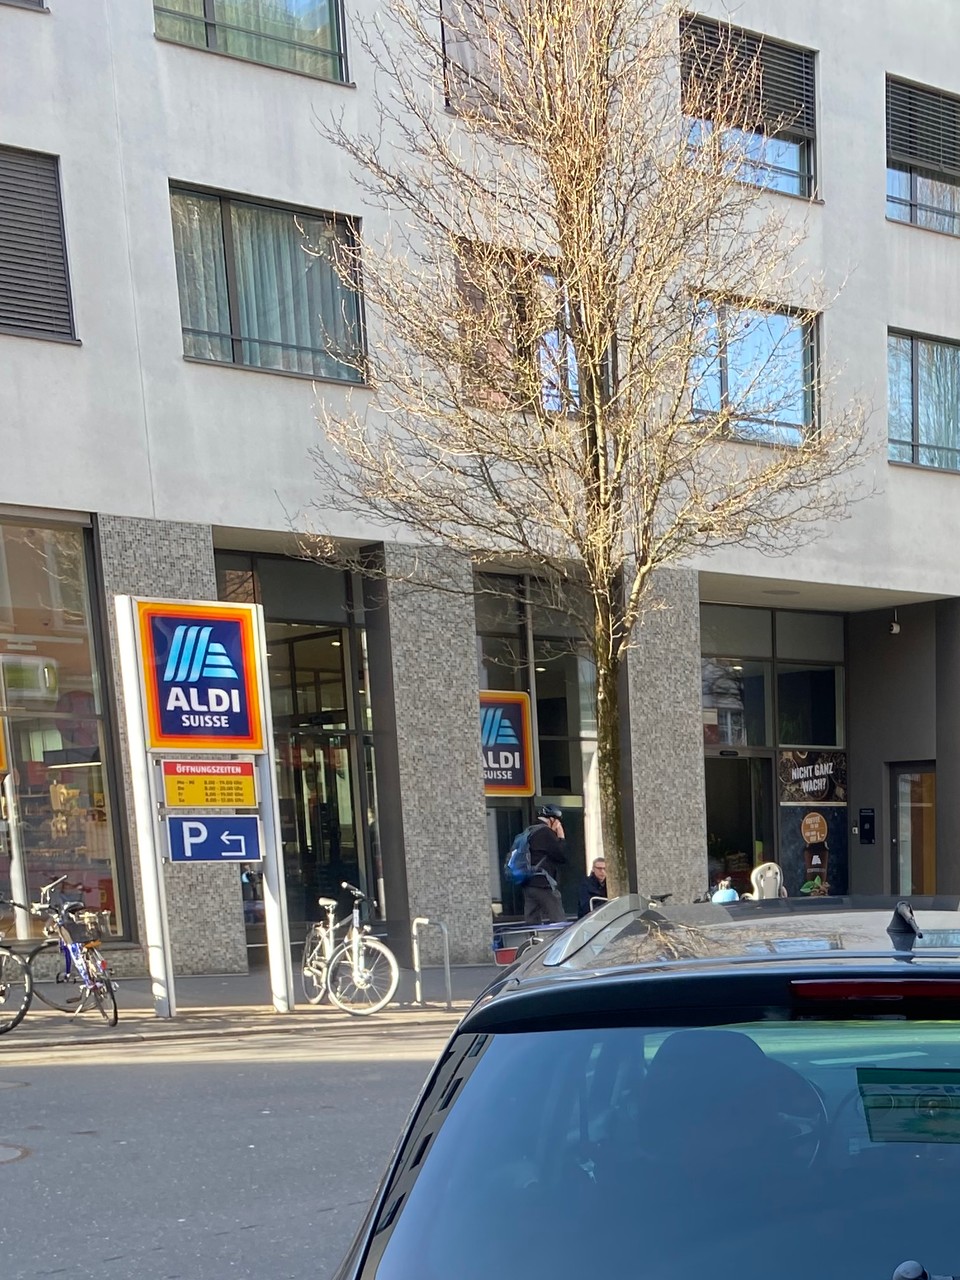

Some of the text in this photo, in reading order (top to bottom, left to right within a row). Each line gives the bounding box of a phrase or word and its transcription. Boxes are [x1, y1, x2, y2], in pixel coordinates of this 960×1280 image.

[166, 686, 240, 713] ALDI
[182, 714, 229, 728] SUISSE
[176, 763, 242, 774] ÖFFNUNGSZEITEN
[792, 762, 834, 780] NICHT GANZ
[802, 778, 827, 792] WACH?
[182, 821, 208, 857] P
